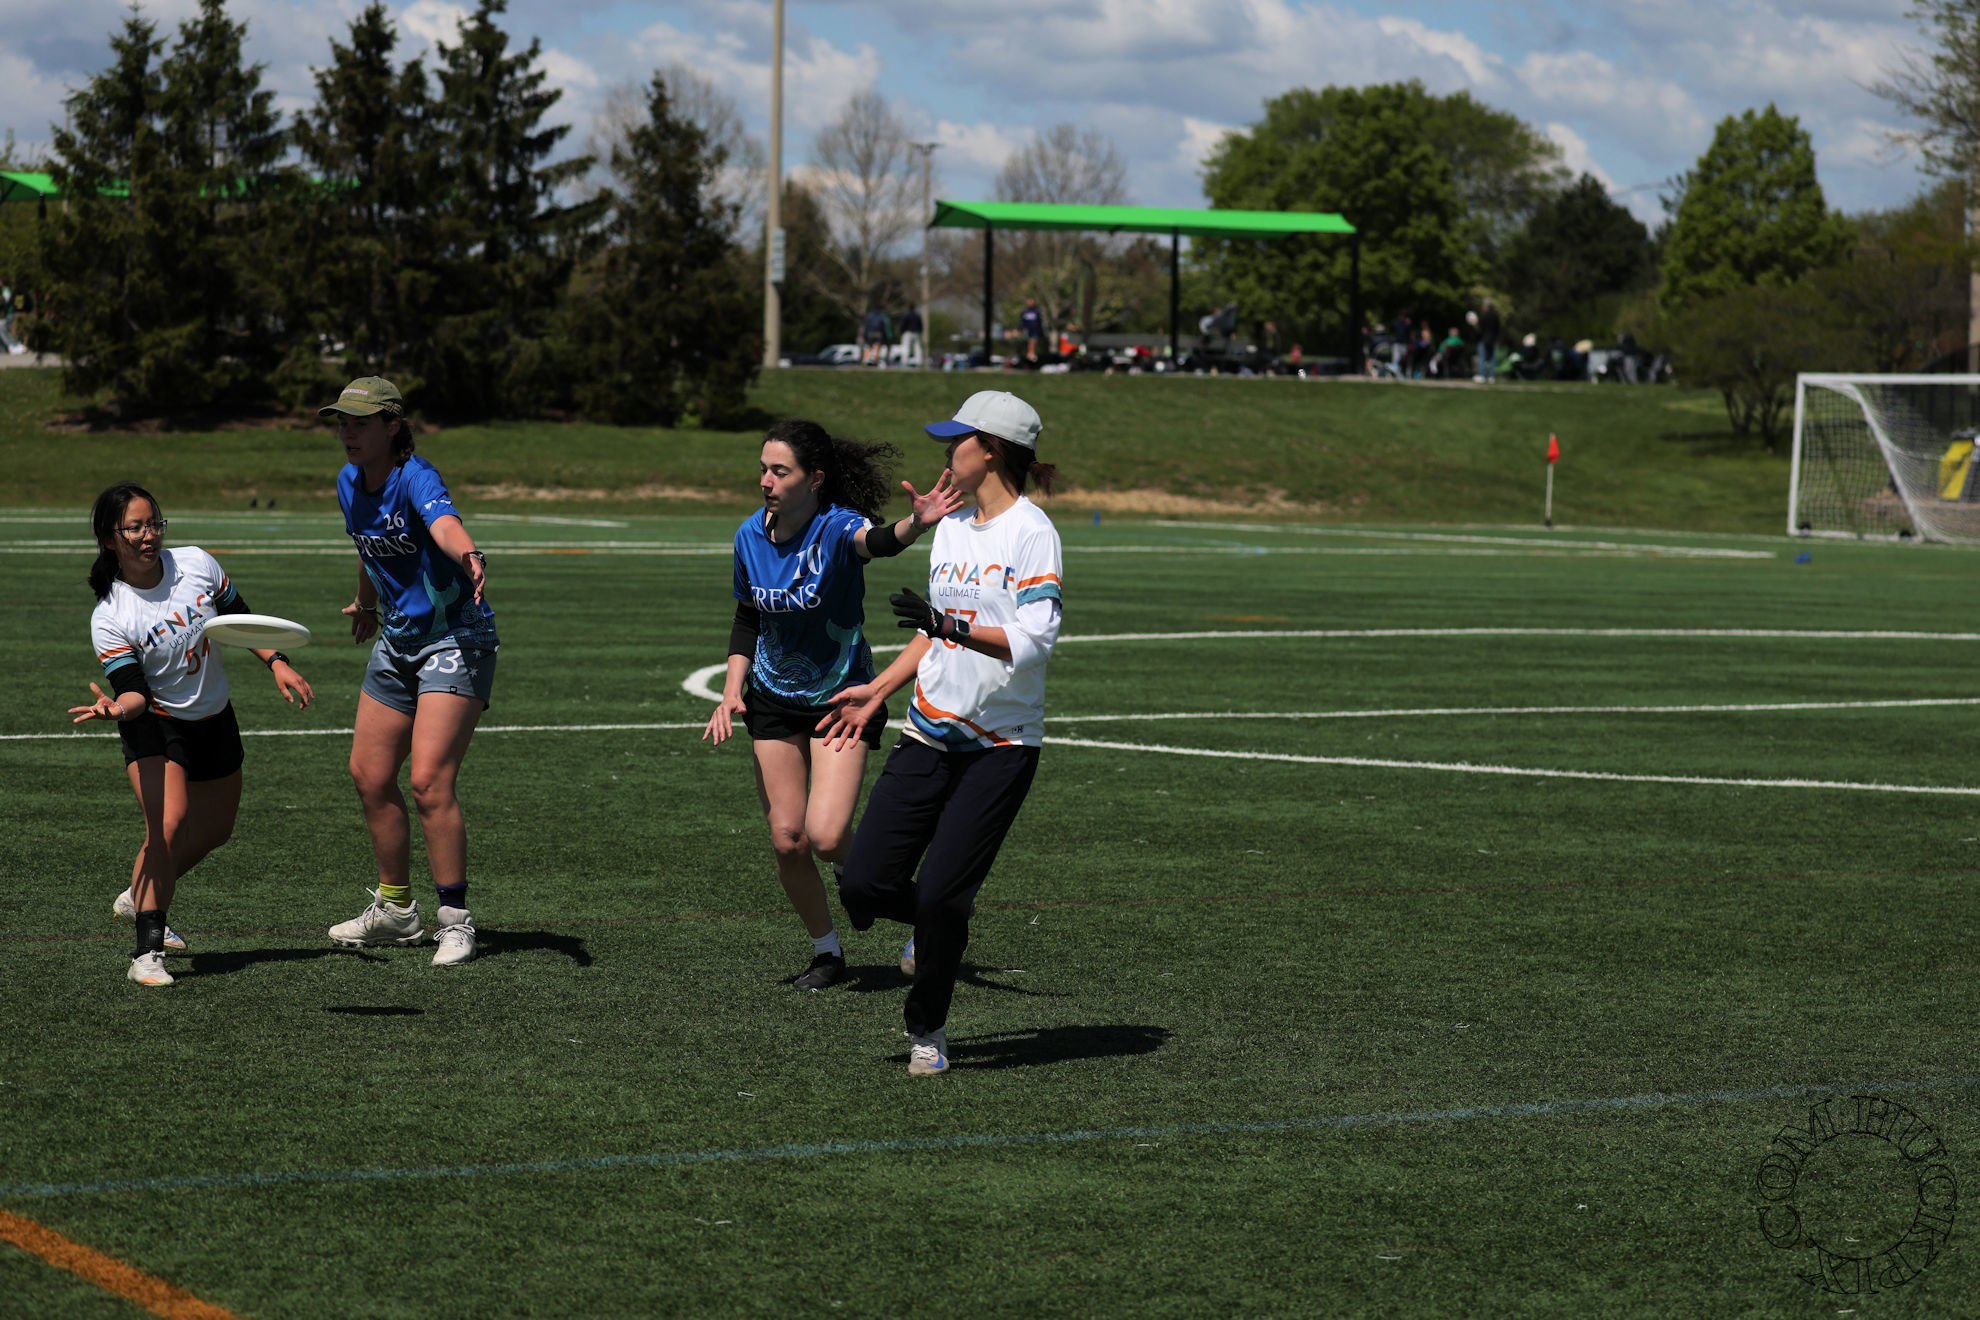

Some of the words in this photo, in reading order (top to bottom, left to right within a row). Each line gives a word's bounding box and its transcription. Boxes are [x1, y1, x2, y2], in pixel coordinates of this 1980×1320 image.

[384, 511, 405, 530] 26
[793, 543, 822, 580] 10
[938, 587, 981, 600] ULTIMATE
[169, 618, 207, 649] ULTIMAT
